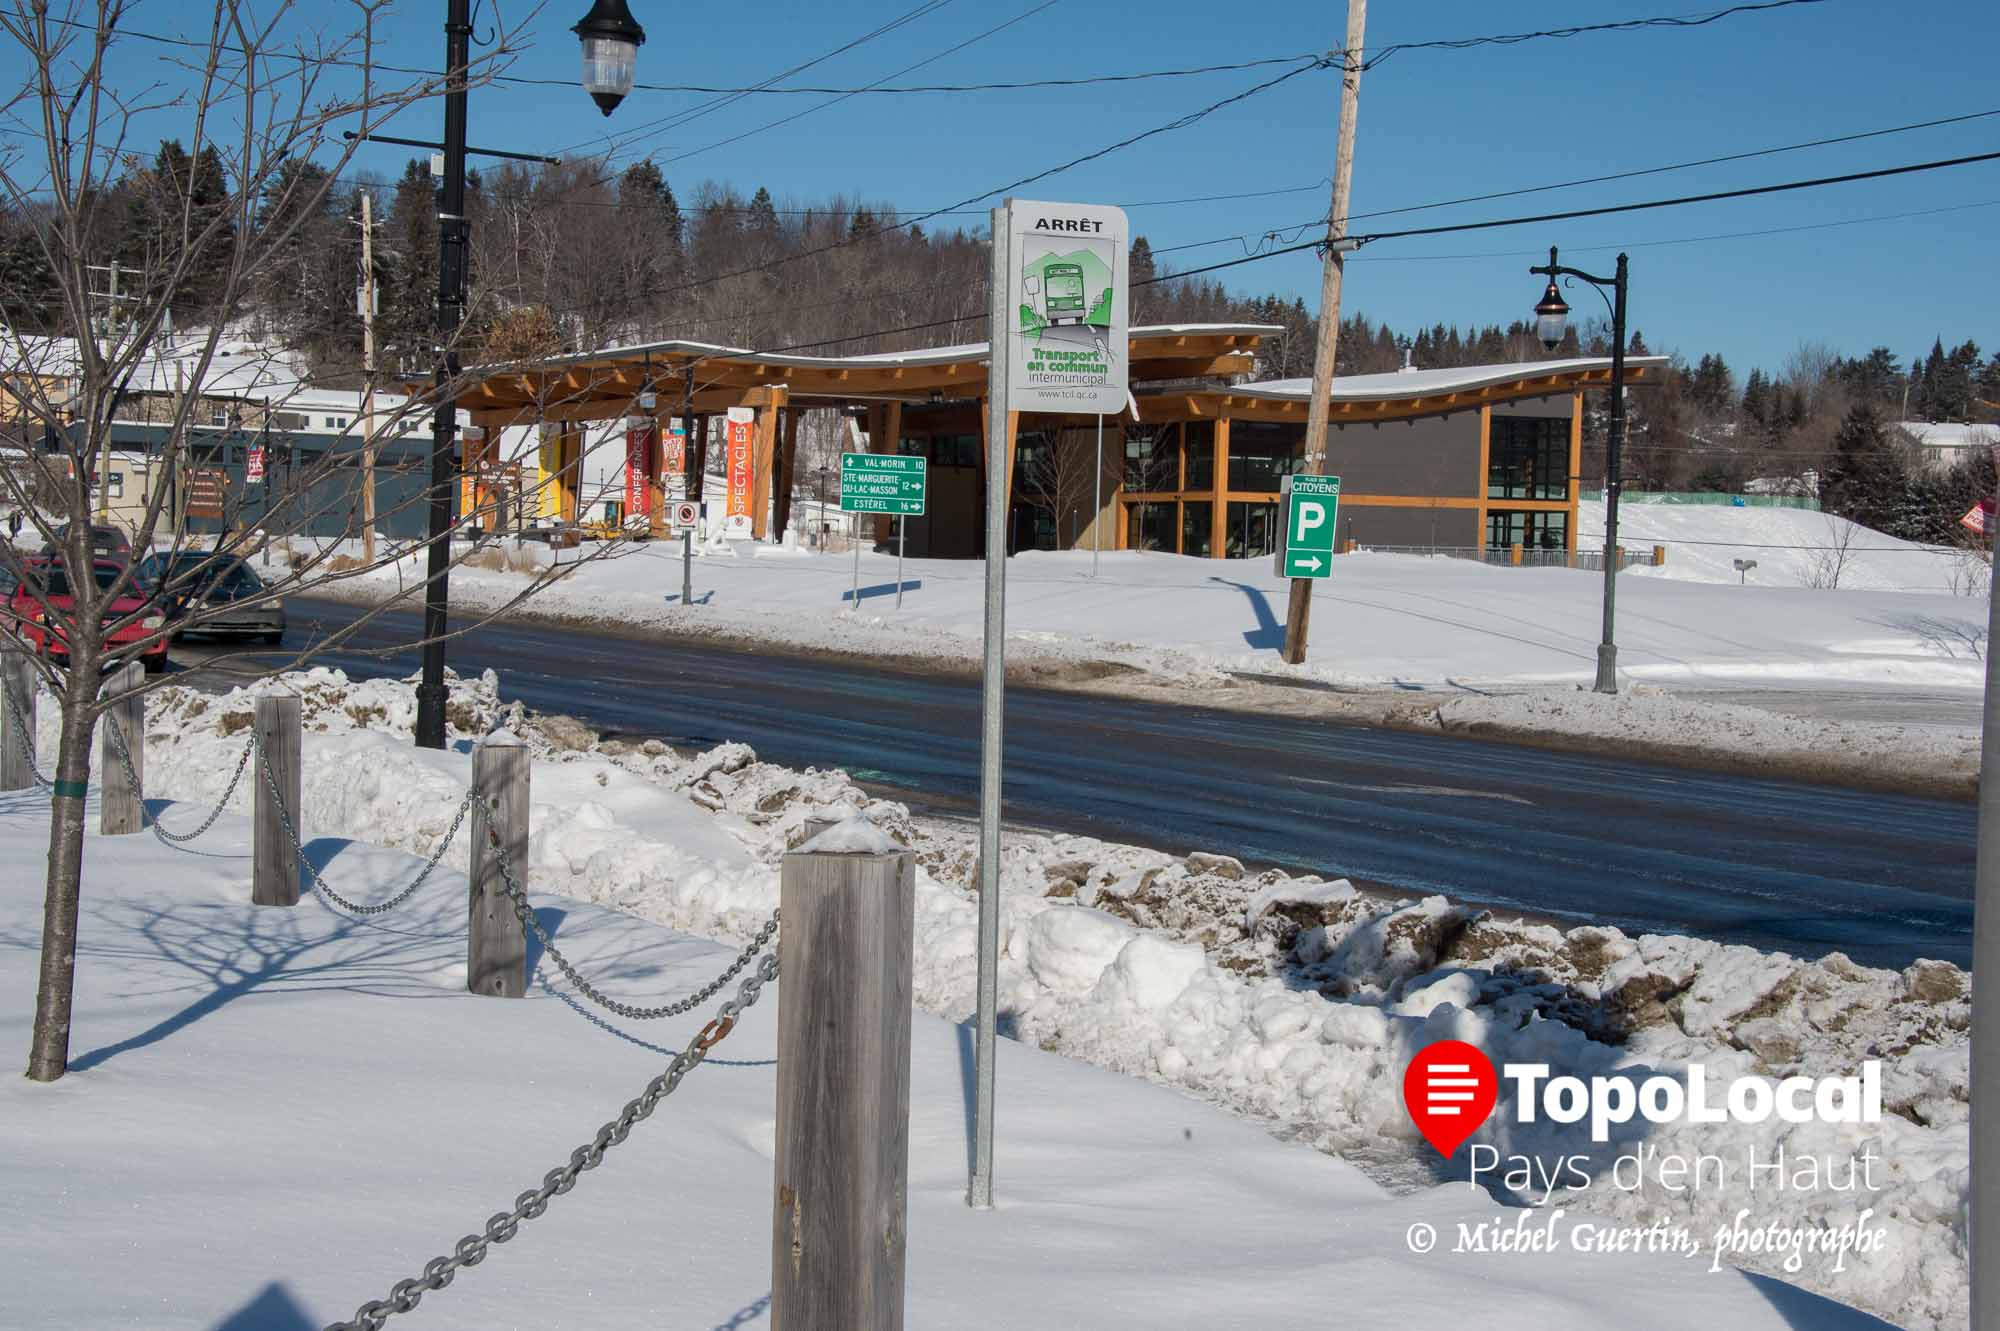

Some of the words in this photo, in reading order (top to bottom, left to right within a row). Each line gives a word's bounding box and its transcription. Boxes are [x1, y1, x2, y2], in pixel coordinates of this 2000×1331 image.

[1035, 218, 1103, 233] ARRÊT
[1032, 347, 1099, 365] Transport
[1026, 361, 1044, 371] en
[1049, 361, 1108, 373] commun
[1028, 372, 1106, 386] intermunicipal
[734, 425, 747, 513] SPECTACLES
[864, 458, 906, 469] VAL-MORIN
[915, 461, 924, 470] 10
[843, 484, 898, 495] DU-LAC-MASSON
[902, 481, 910, 490] 12
[1293, 481, 1338, 494] CITOYENS
[854, 498, 888, 510] ESTÉREL
[900, 502, 909, 511] 16
[1296, 501, 1326, 542] P
